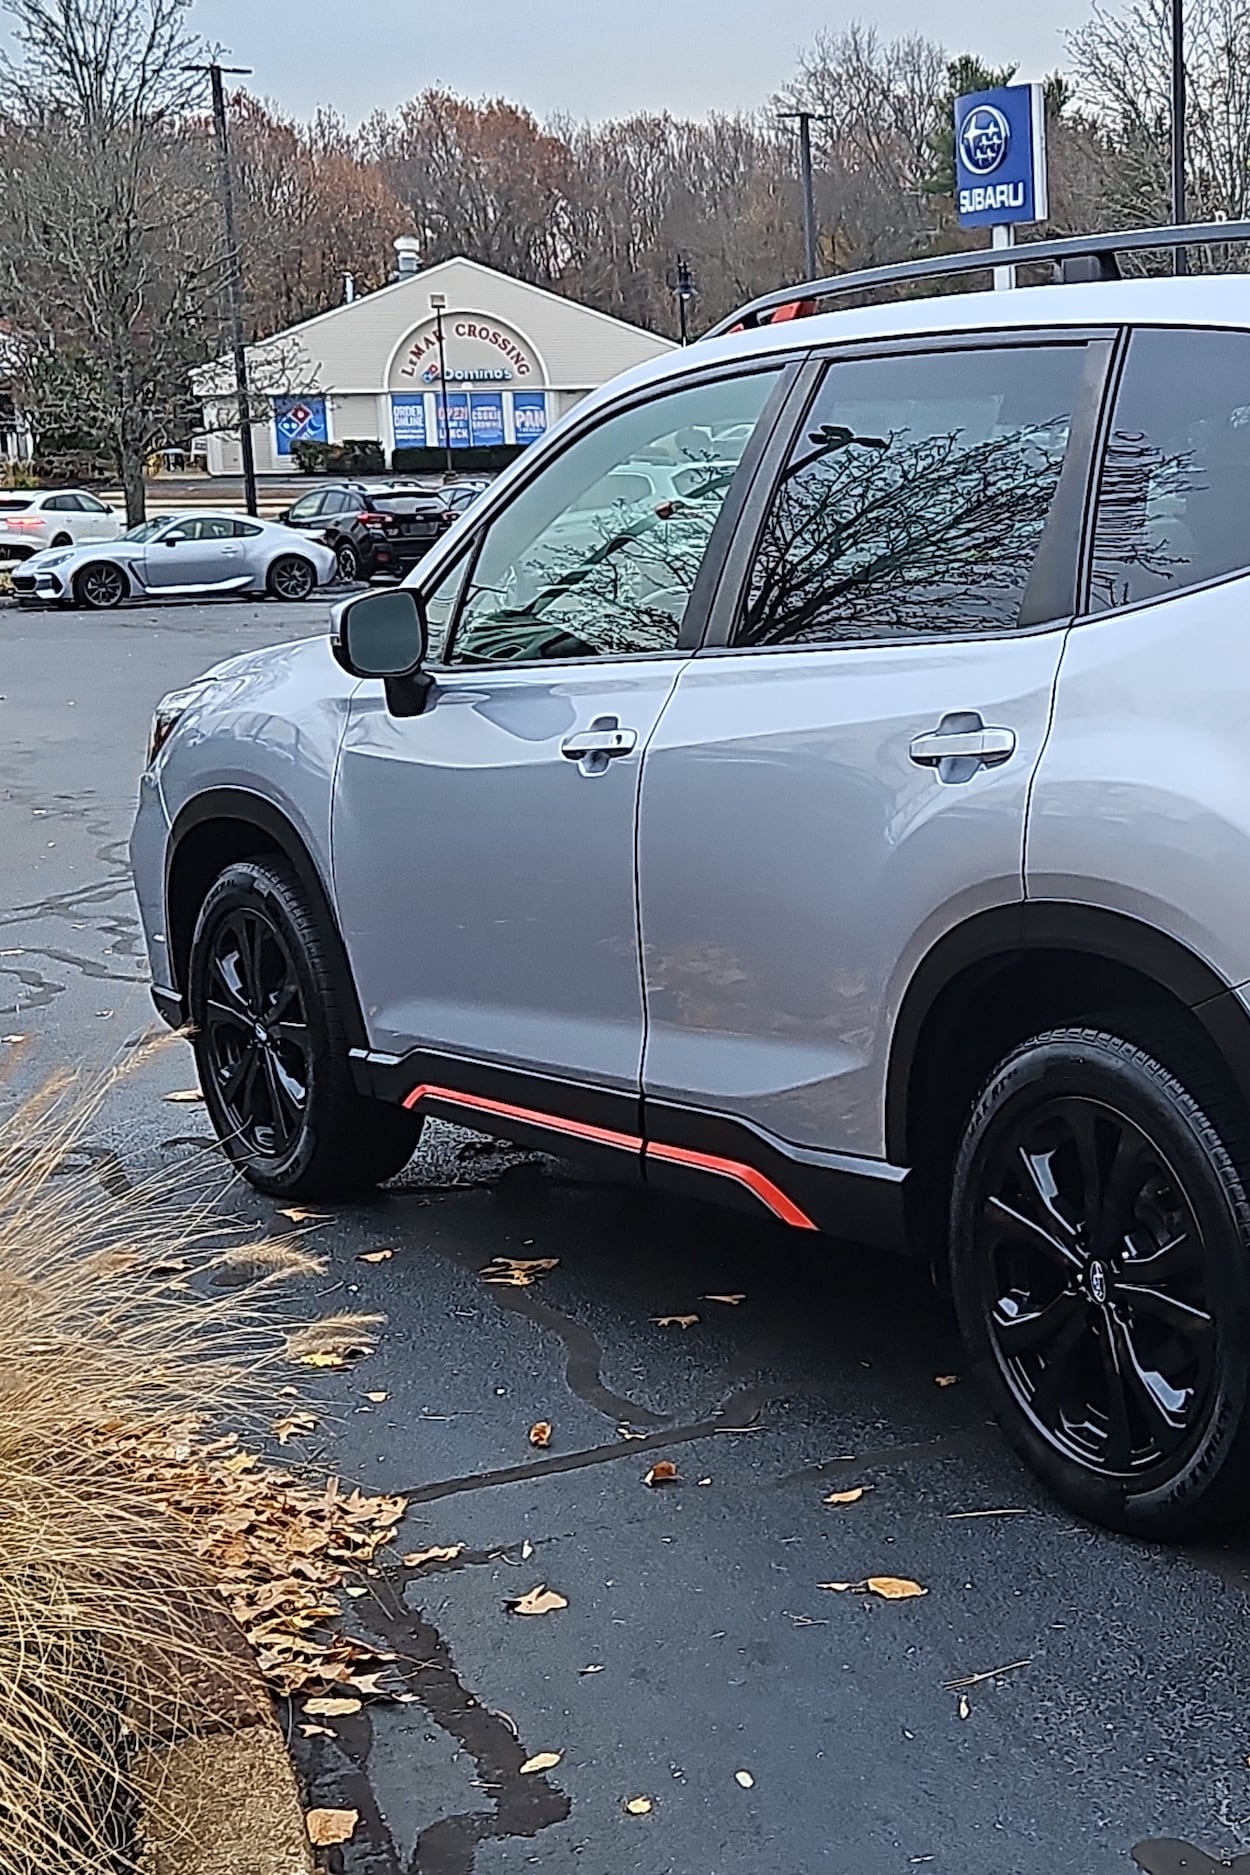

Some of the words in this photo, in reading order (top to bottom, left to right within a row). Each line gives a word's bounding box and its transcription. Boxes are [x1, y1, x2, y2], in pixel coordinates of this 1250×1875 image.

[959, 181, 1024, 214] SUBARU
[455, 323, 530, 376] CROSSING
[394, 417, 425, 428] ONLINE
[514, 410, 546, 428] PAN
